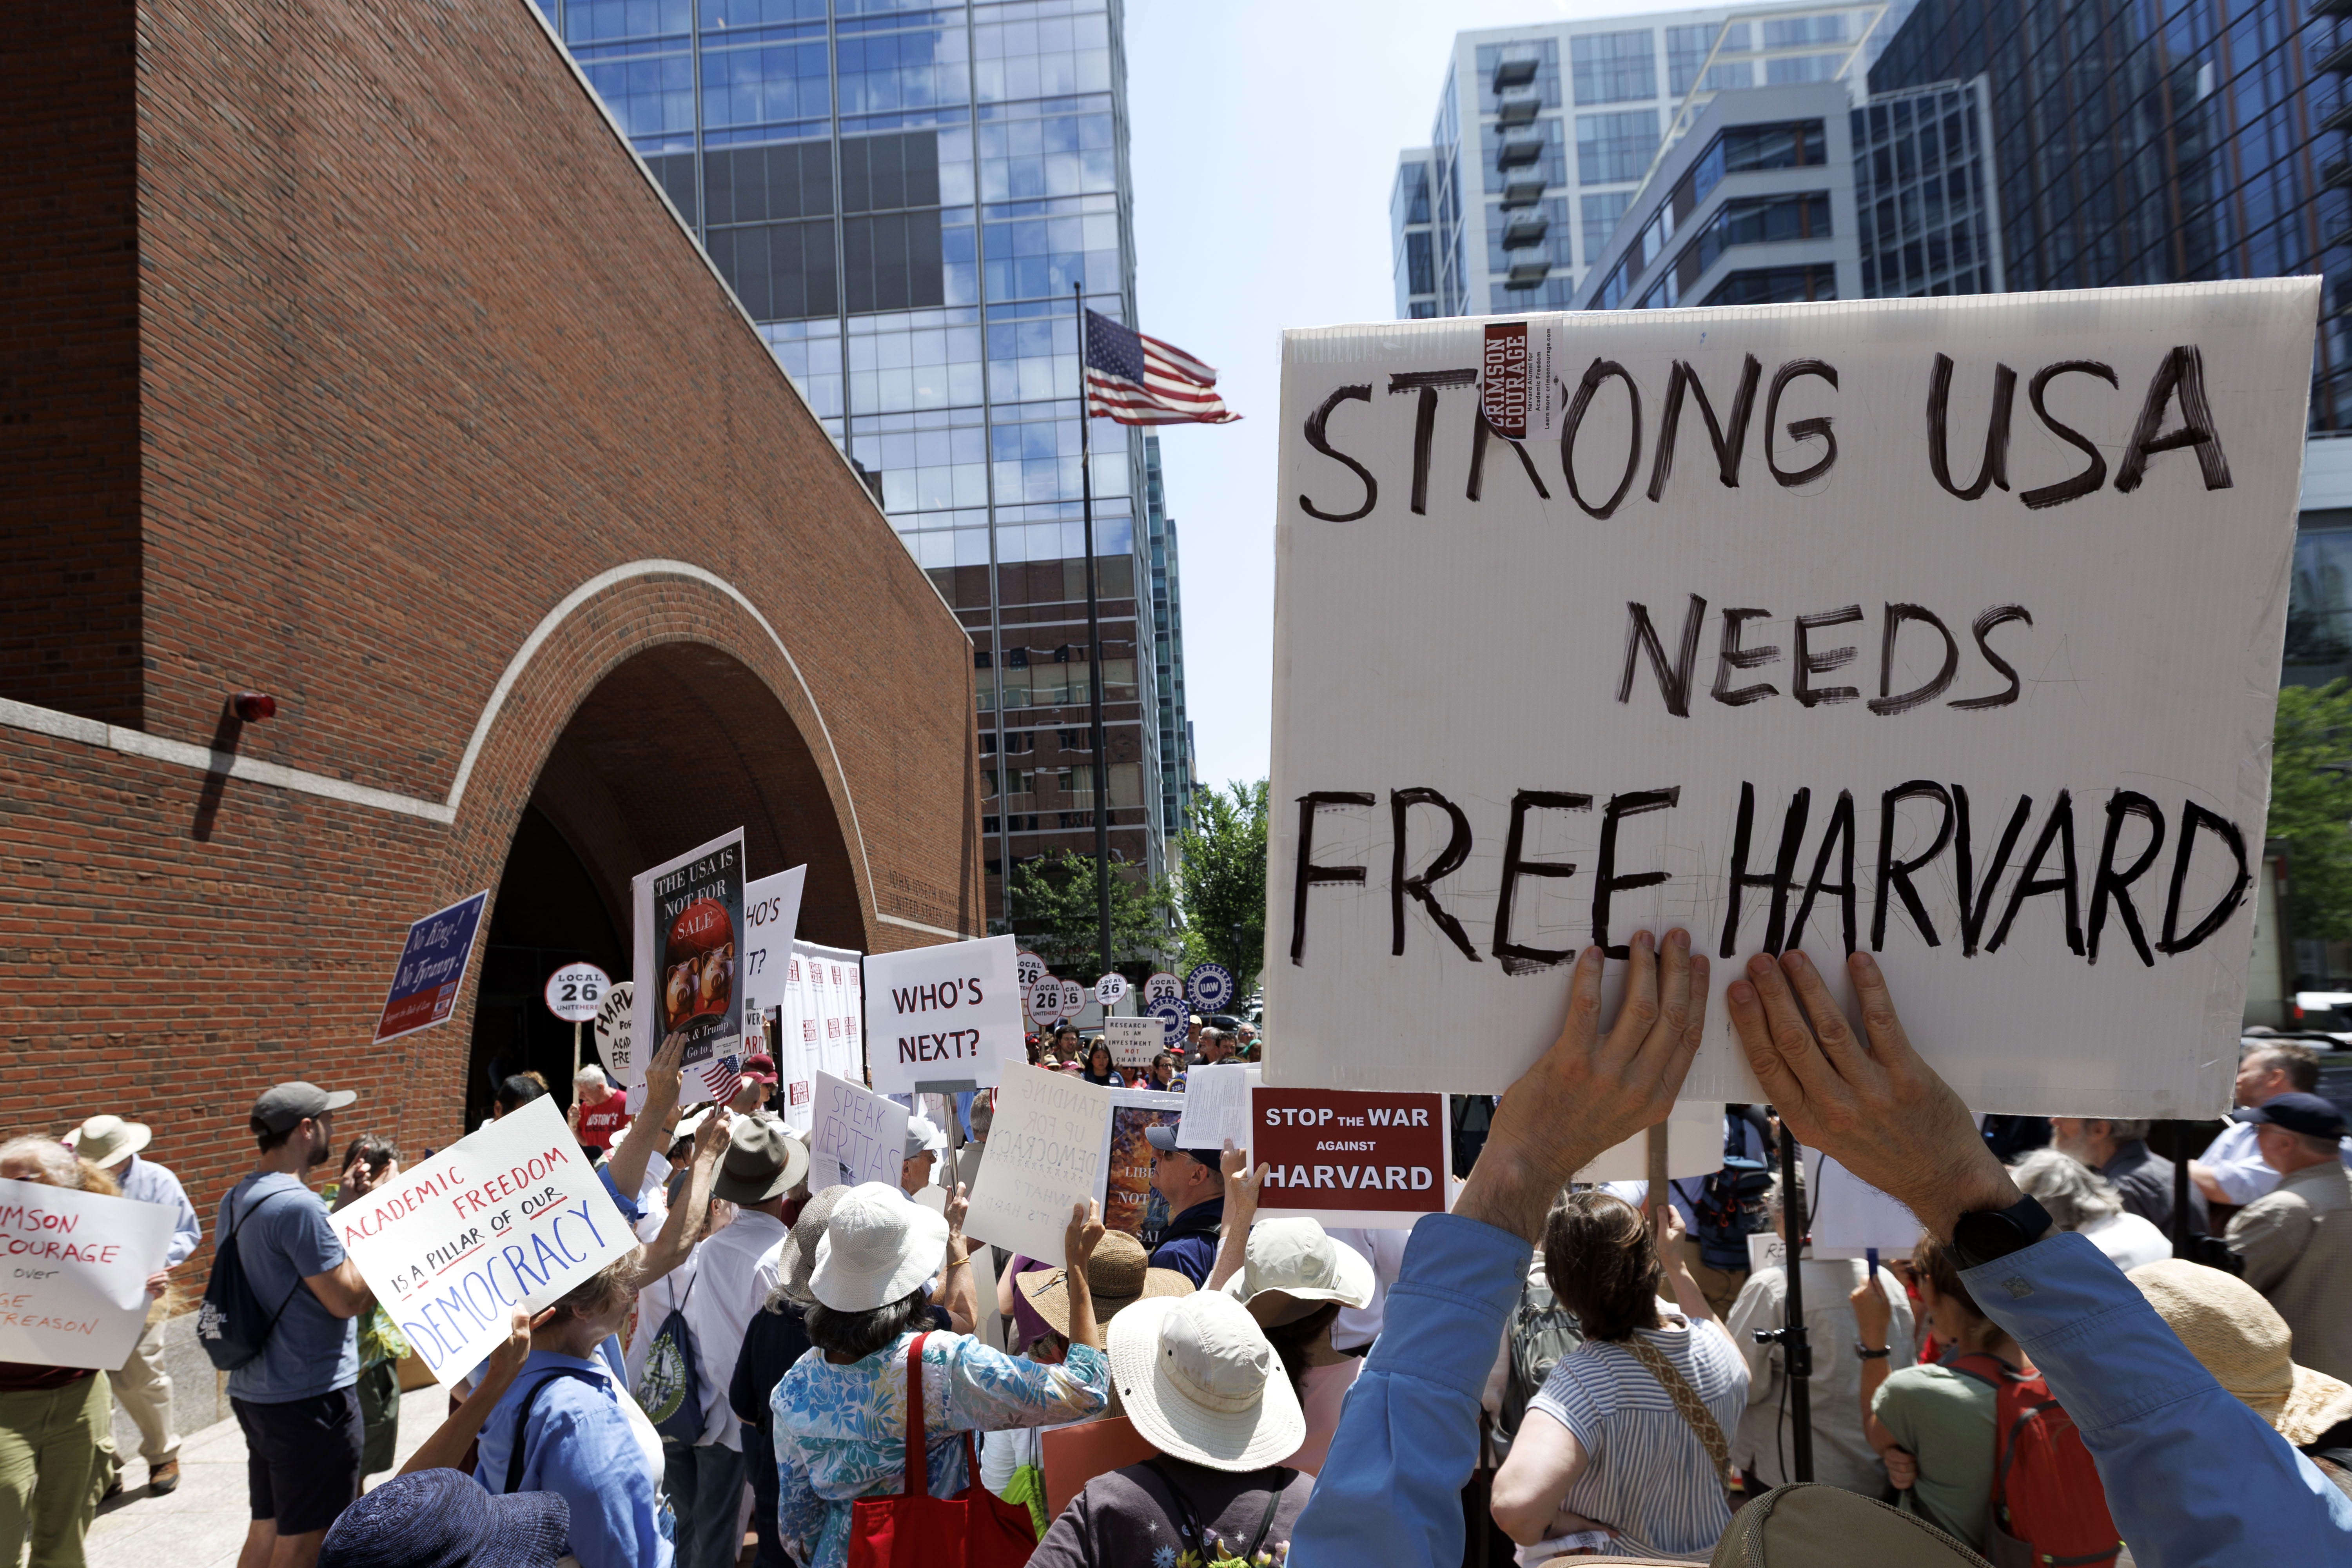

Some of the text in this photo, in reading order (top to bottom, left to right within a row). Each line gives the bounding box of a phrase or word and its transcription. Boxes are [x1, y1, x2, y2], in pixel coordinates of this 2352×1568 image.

[1486, 339, 1505, 427] CRIMSON
[1506, 336, 1525, 428] COURAGE
[1299, 344, 2234, 523] STRONG USA
[1615, 592, 2033, 719] NEEDS
[657, 849, 733, 897] THE USA IS
[889, 869, 909, 893] JOHN
[913, 879, 936, 902] JOSEPH
[1290, 780, 2252, 976] FREE HARVARD
[664, 880, 726, 919] NOT FOR
[746, 897, 780, 928] HO'S
[890, 893, 918, 917] UNITED
[922, 903, 942, 924] STATES
[407, 910, 465, 955] No King!
[677, 911, 713, 939] SALE
[394, 942, 466, 993] No Tyranny!
[1018, 969, 1038, 984] 26
[561, 984, 597, 1001] 26
[892, 977, 983, 1014] WHO'S
[1036, 992, 1056, 1008] 26
[1102, 984, 1119, 995] 26
[1153, 986, 1174, 998] 26
[1200, 982, 1218, 993] UAW
[597, 989, 633, 1037] HARV
[746, 1013, 760, 1025] VER
[613, 1036, 631, 1050] ACAD
[693, 1029, 700, 1040] &
[702, 1022, 728, 1036] Trump
[898, 1028, 980, 1064] NEXT?
[612, 1051, 630, 1068] FRE
[687, 1047, 698, 1058] Go
[701, 1046, 708, 1054] to
[832, 1086, 885, 1133] SPEAK
[1265, 1108, 1429, 1127] STOP THE WAR
[815, 1109, 900, 1187] VERITAS
[1316, 1141, 1376, 1151] AGAINST
[452, 1147, 569, 1220] FREEDOM
[1125, 1167, 1156, 1178] LIBE
[1263, 1164, 1433, 1191] HARVARD
[345, 1165, 465, 1247] ACADEMIC
[1118, 1192, 1150, 1205] NOT
[391, 1186, 563, 1293] IS A PILLAR OF OUR
[13, 1269, 60, 1279] over
[402, 1200, 605, 1370] DEMOCRACY
